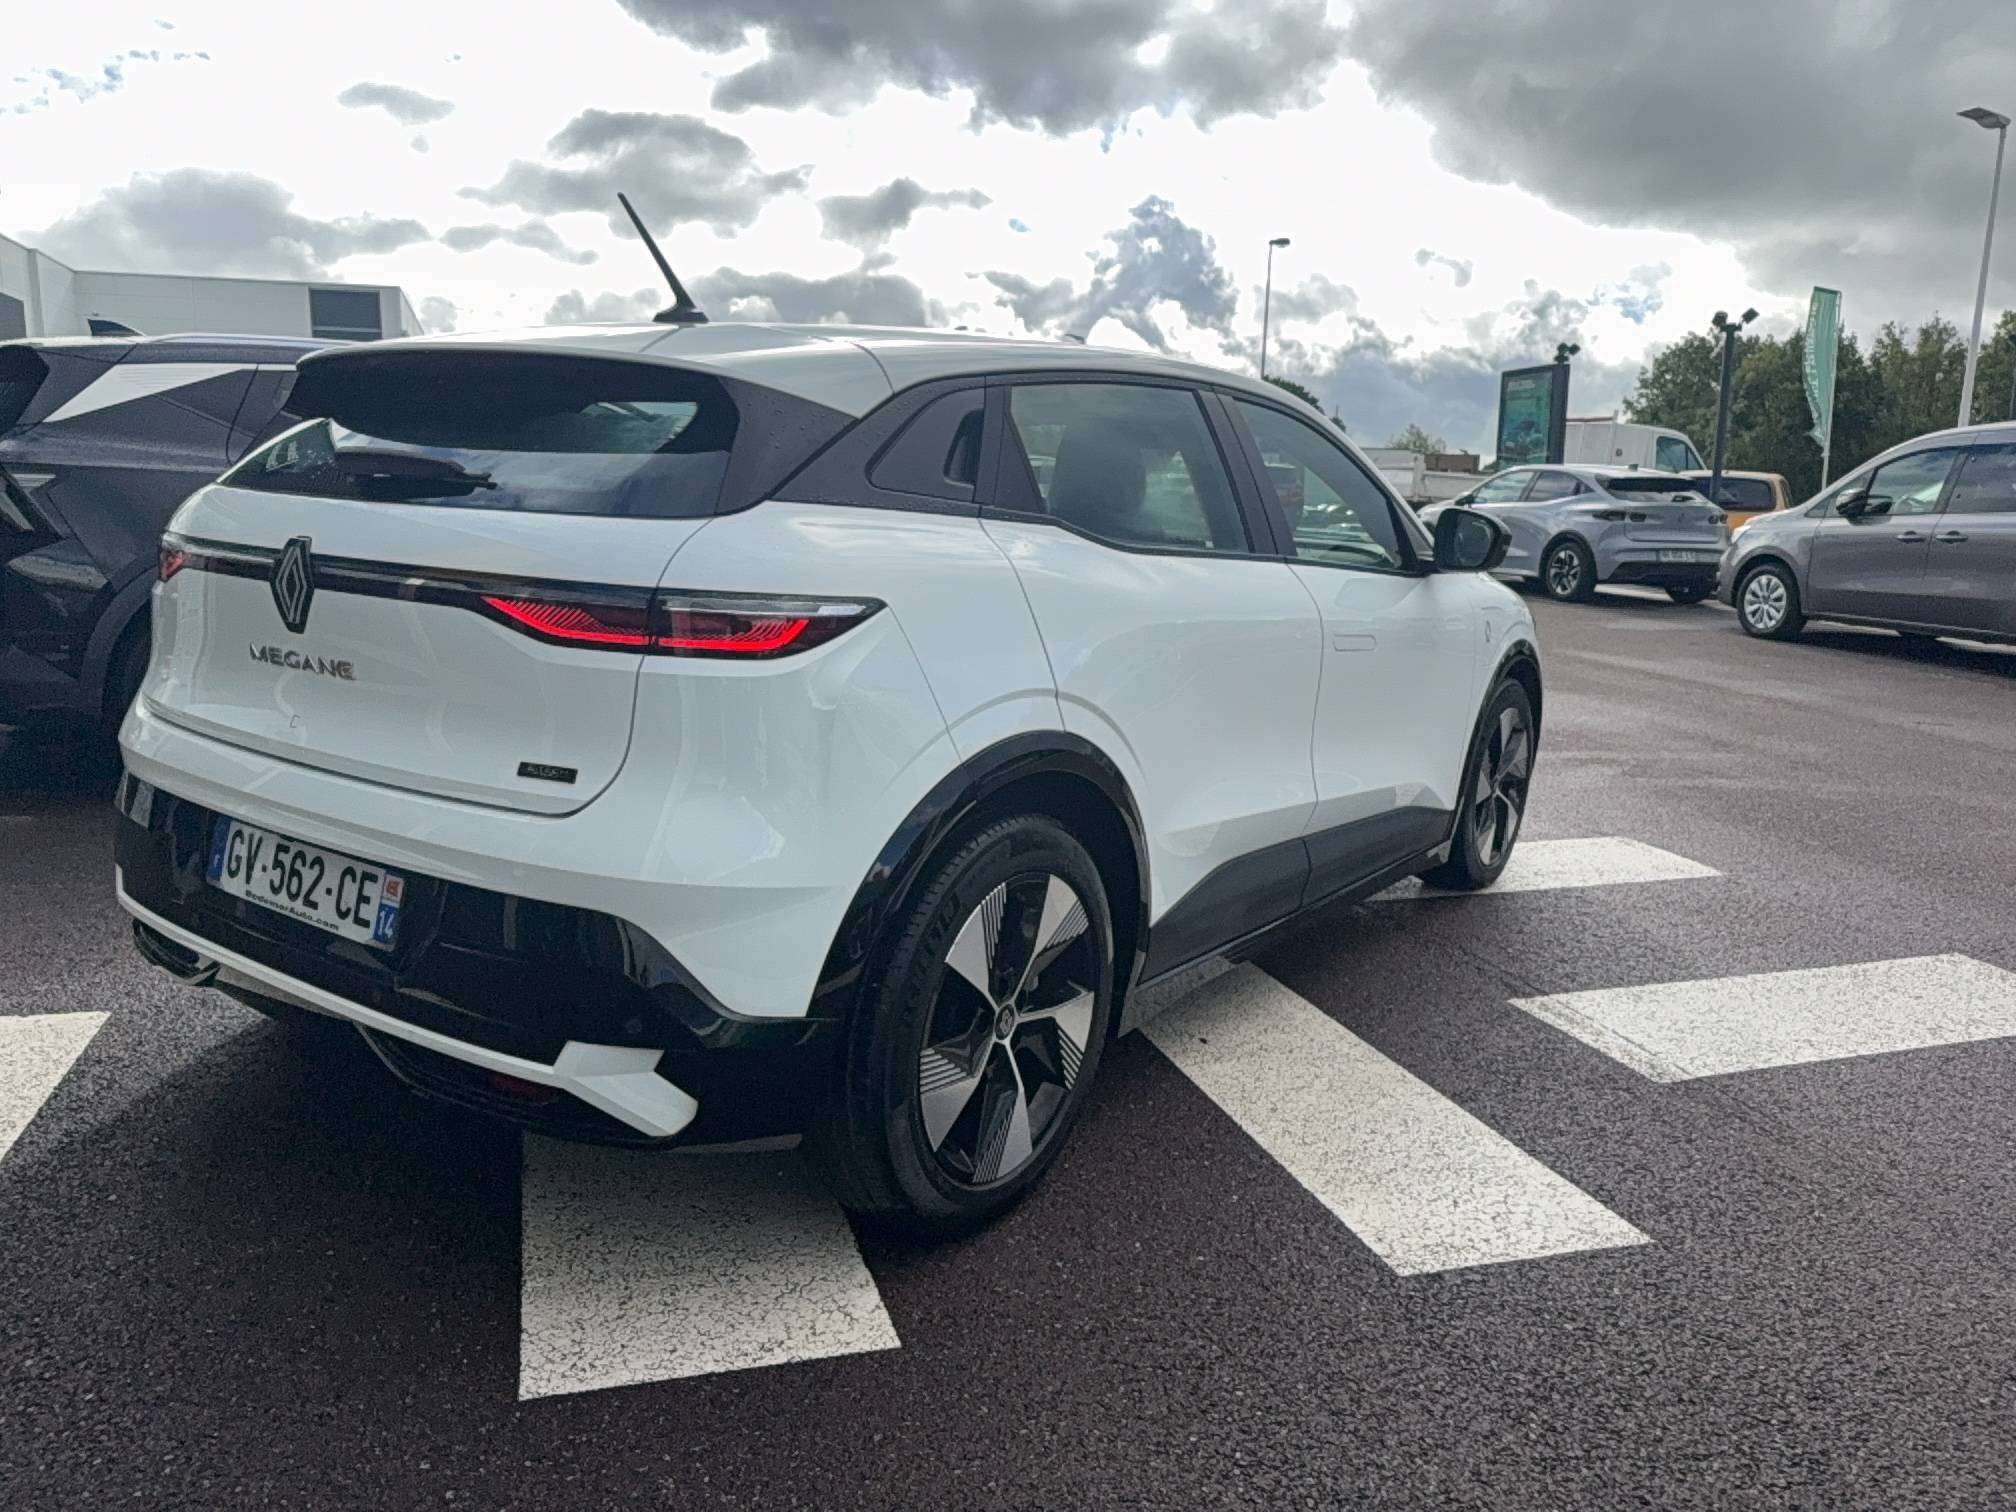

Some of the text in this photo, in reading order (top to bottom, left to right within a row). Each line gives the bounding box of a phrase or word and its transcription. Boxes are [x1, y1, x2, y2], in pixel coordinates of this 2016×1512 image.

[249, 641, 355, 681] MEGANE
[226, 828, 379, 929] GV-562-CE
[377, 910, 395, 939] 14
